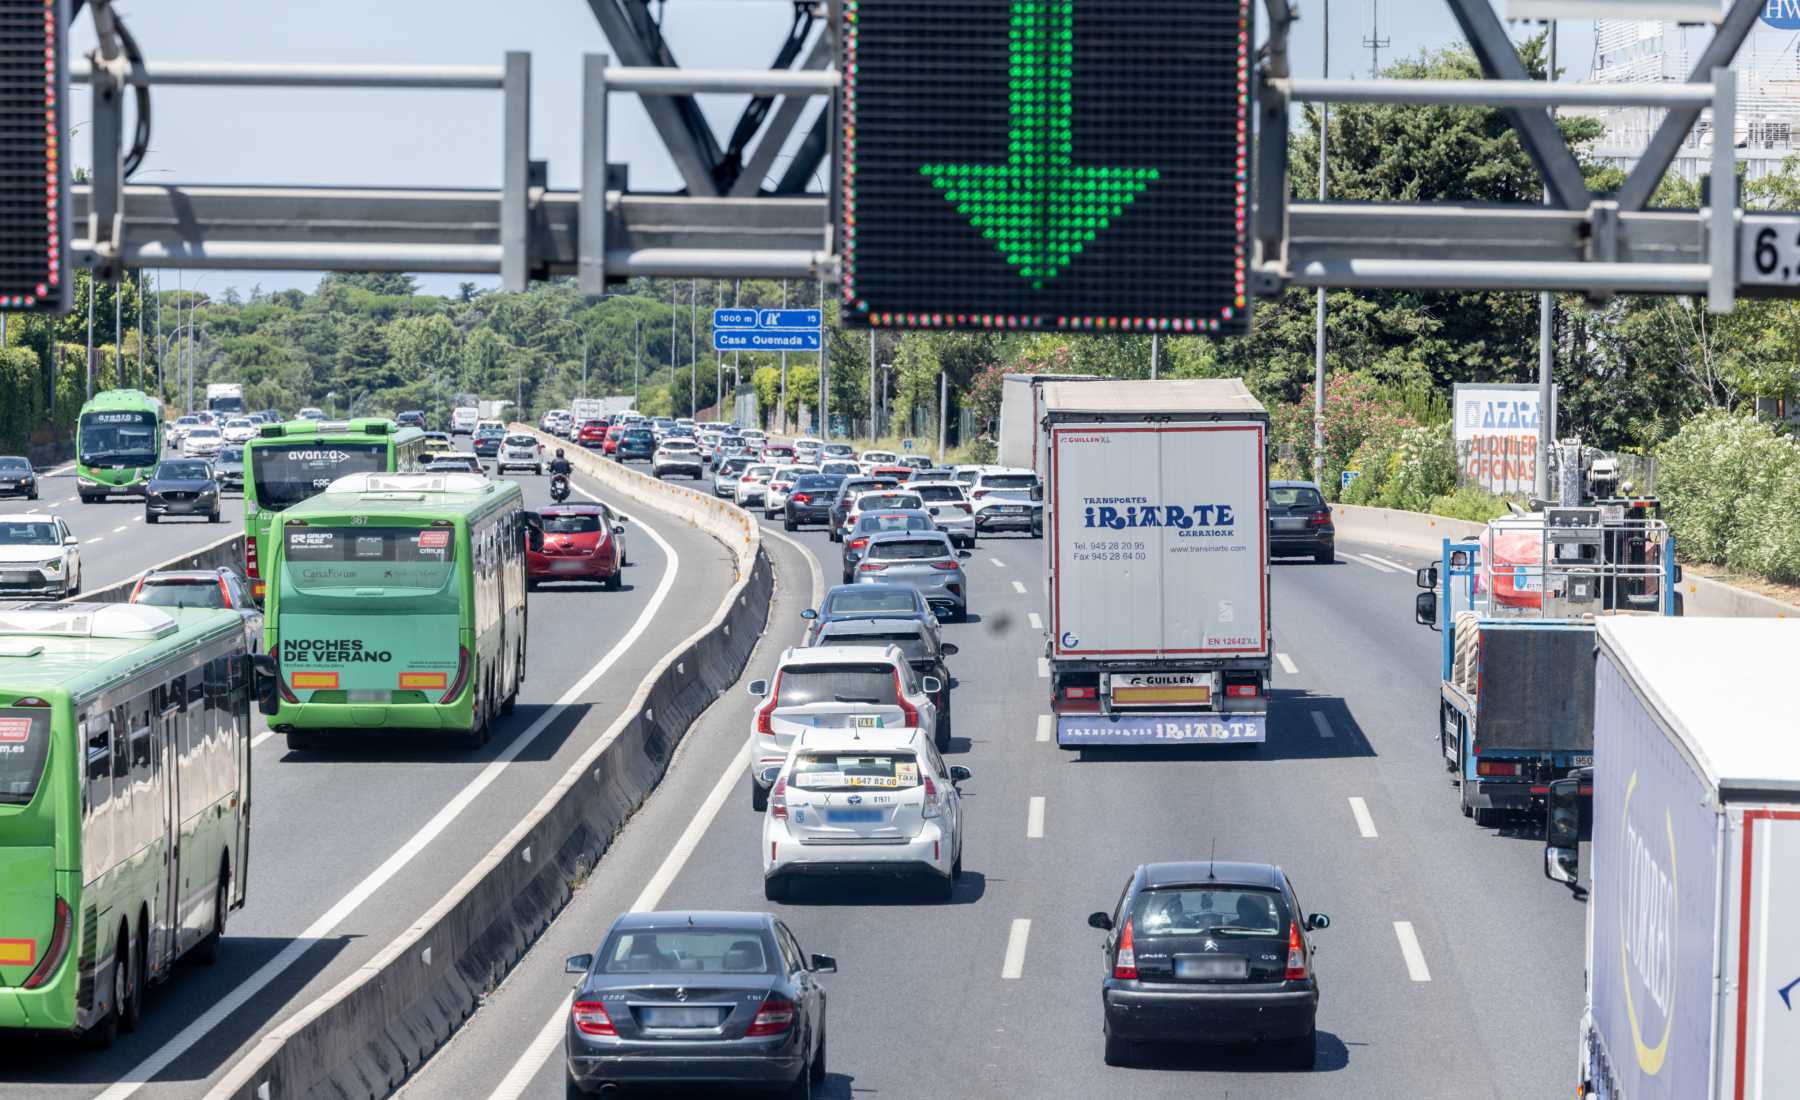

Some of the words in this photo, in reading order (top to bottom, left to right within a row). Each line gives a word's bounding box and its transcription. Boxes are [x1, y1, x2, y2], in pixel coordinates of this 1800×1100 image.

[1755, 227, 1800, 279] 6,
[720, 335, 747, 344] Casa
[752, 335, 803, 345] Quemada
[288, 450, 337, 462] avanza
[1469, 459, 1536, 480] OFCINAS
[1073, 542, 1088, 550] Tel.
[1090, 542, 1107, 550] 945
[1108, 542, 1119, 550] 28
[1121, 542, 1132, 550] 20
[1134, 542, 1145, 550] 95
[1073, 552, 1089, 560] Fax
[1091, 552, 1107, 560] 945
[1109, 552, 1120, 560] 28
[284, 640, 363, 650] NOCHES
[1208, 637, 1220, 646] EN
[1222, 637, 1246, 645] 12642
[284, 651, 308, 662] DE
[314, 651, 392, 662] VERANO
[1146, 676, 1194, 684] GUILLEN
[1066, 728, 1152, 736] TRANSPORTES
